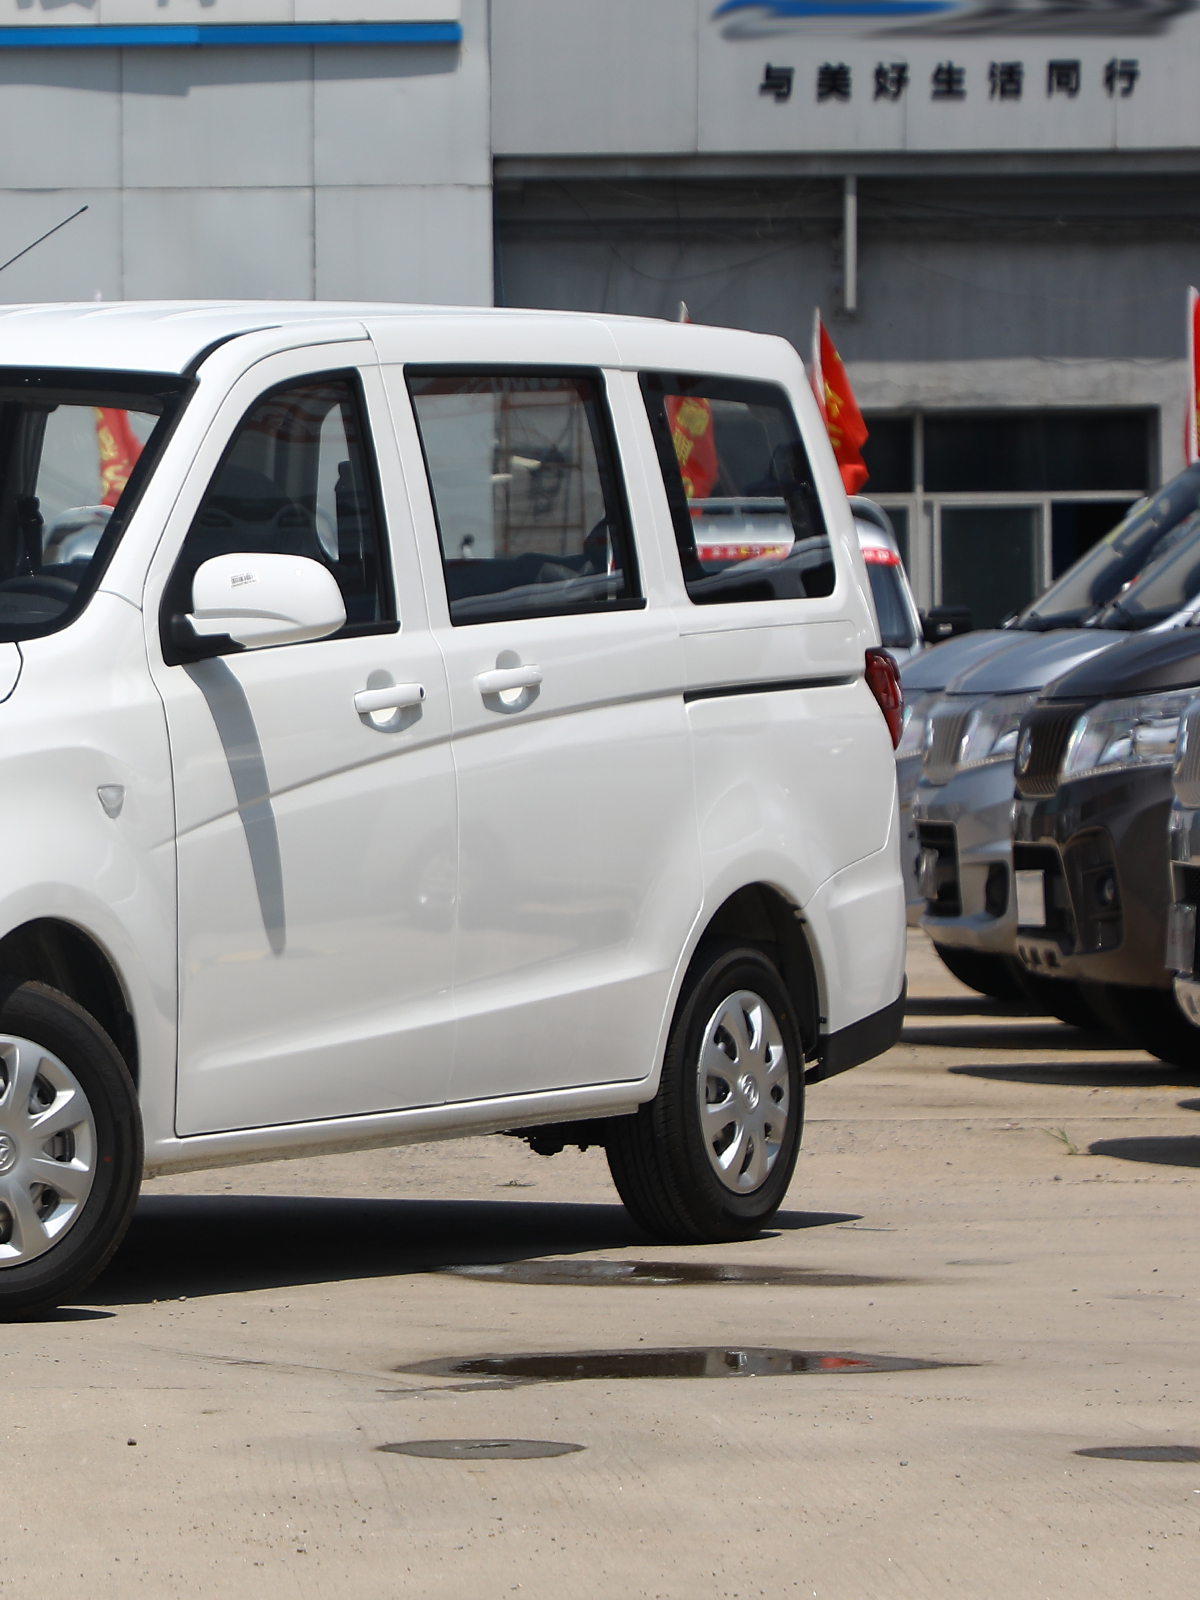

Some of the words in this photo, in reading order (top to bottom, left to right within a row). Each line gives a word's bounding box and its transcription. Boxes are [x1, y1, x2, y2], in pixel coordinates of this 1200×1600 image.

[759, 58, 1140, 102] 与美好生活同行
